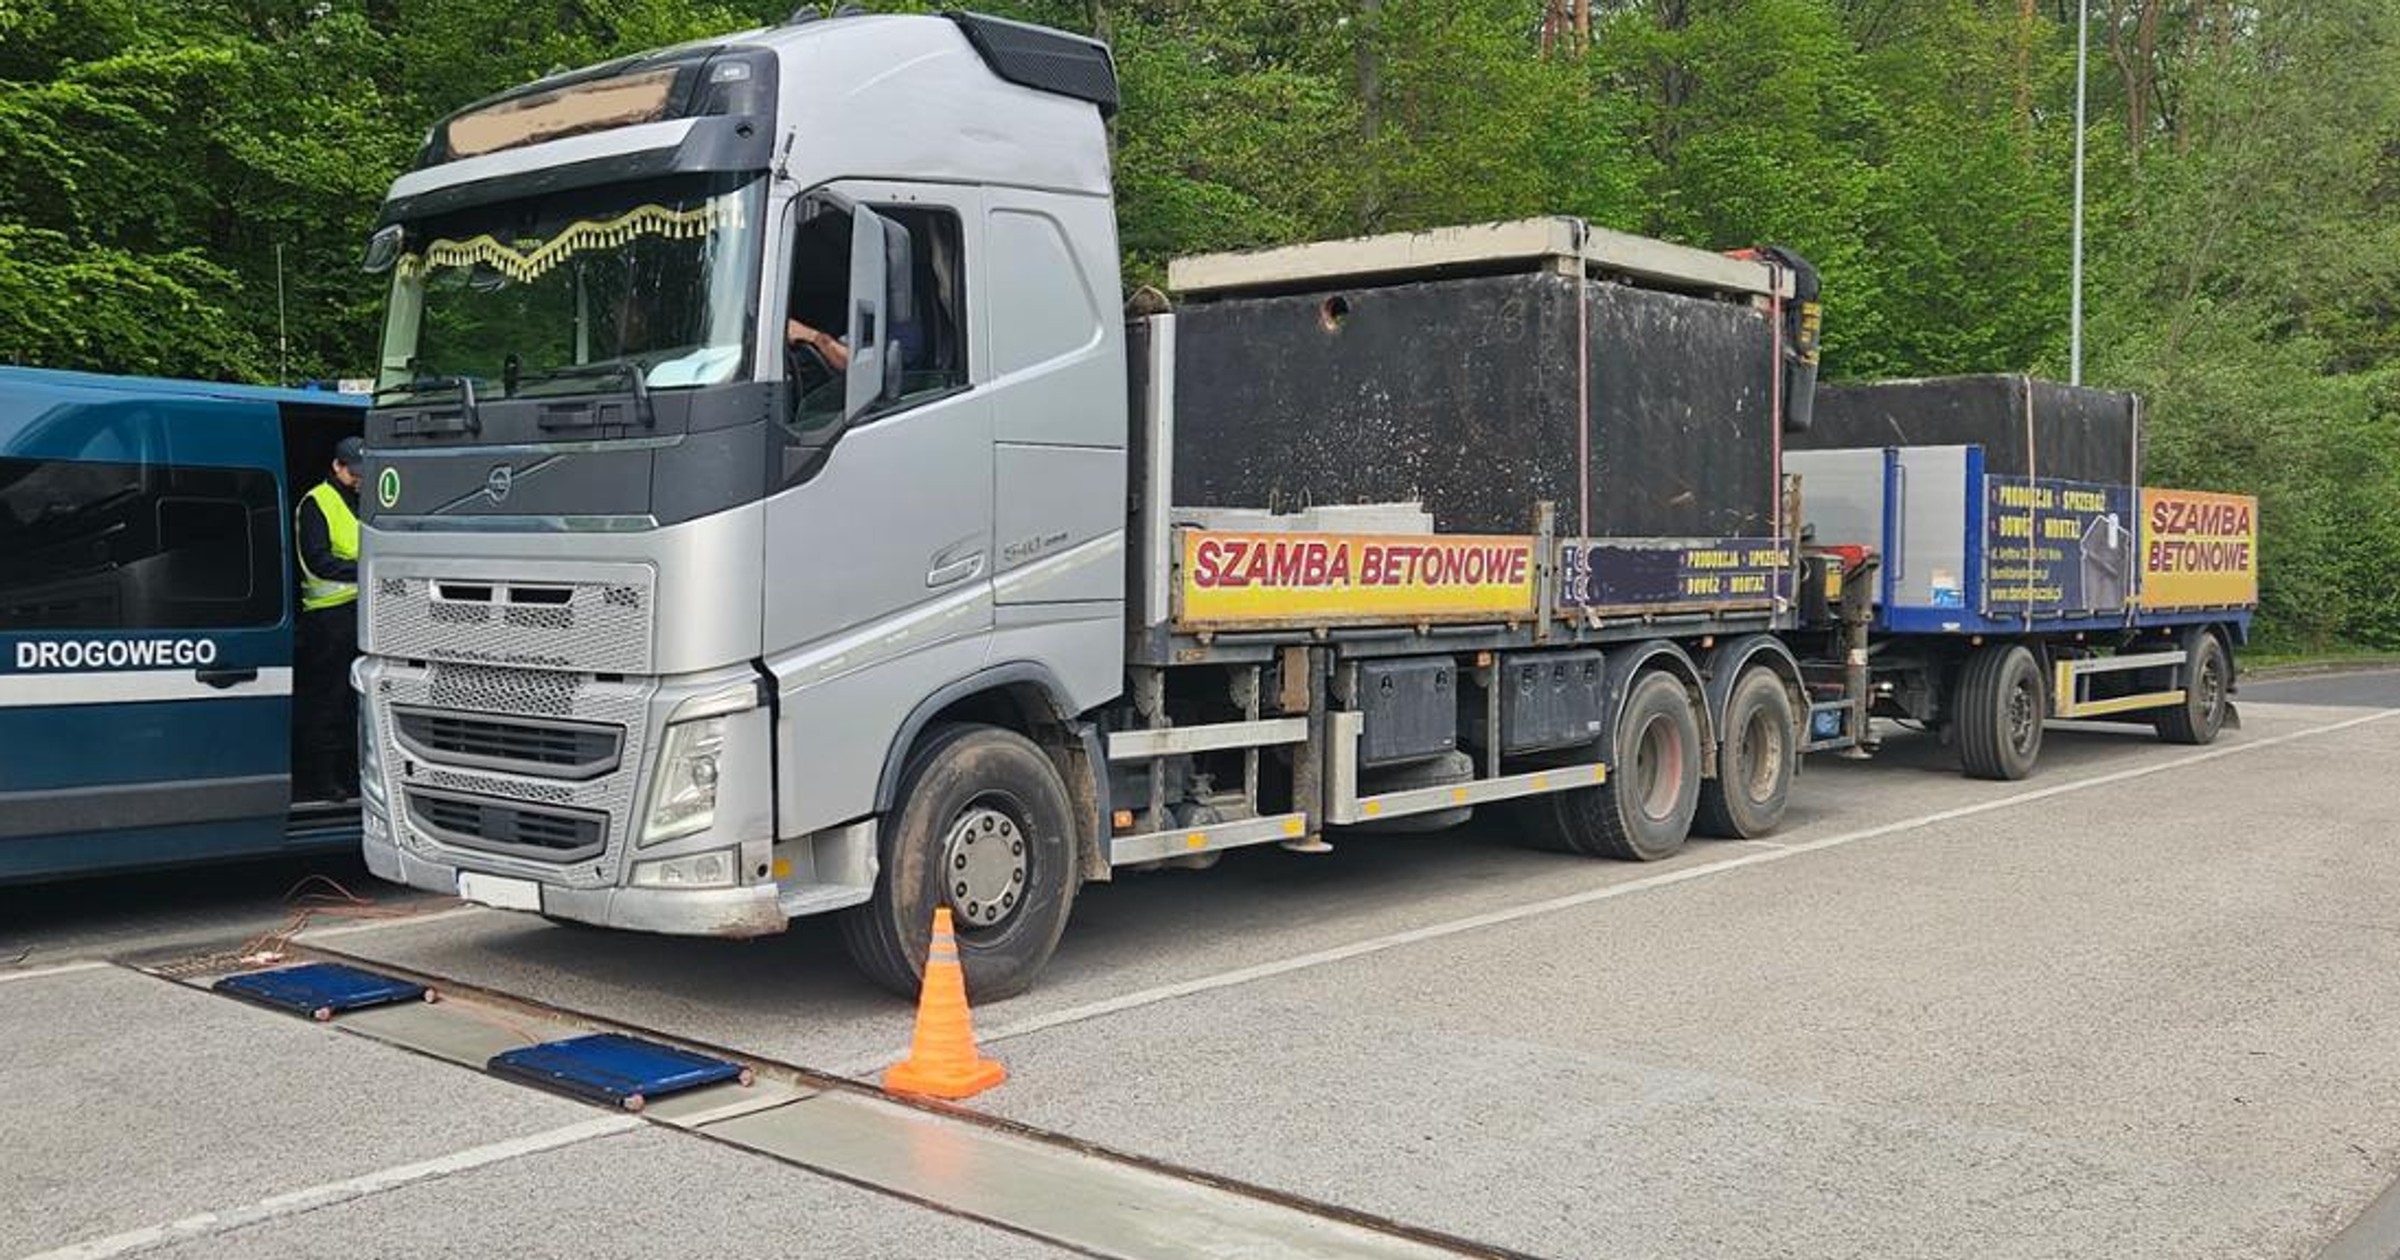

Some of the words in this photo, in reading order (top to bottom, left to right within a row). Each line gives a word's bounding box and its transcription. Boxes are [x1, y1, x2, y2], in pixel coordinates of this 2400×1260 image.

[2000, 485, 2053, 508] PRODUCJA
[2151, 500, 2250, 536] SZAMBA
[1194, 541, 1350, 588] SZAMBA
[1360, 547, 1529, 587] BETONOWE
[1749, 547, 1790, 567] SPRZEAŻ
[2147, 541, 2249, 572] BETONOWE
[15, 638, 217, 669] DROGOWEGO
